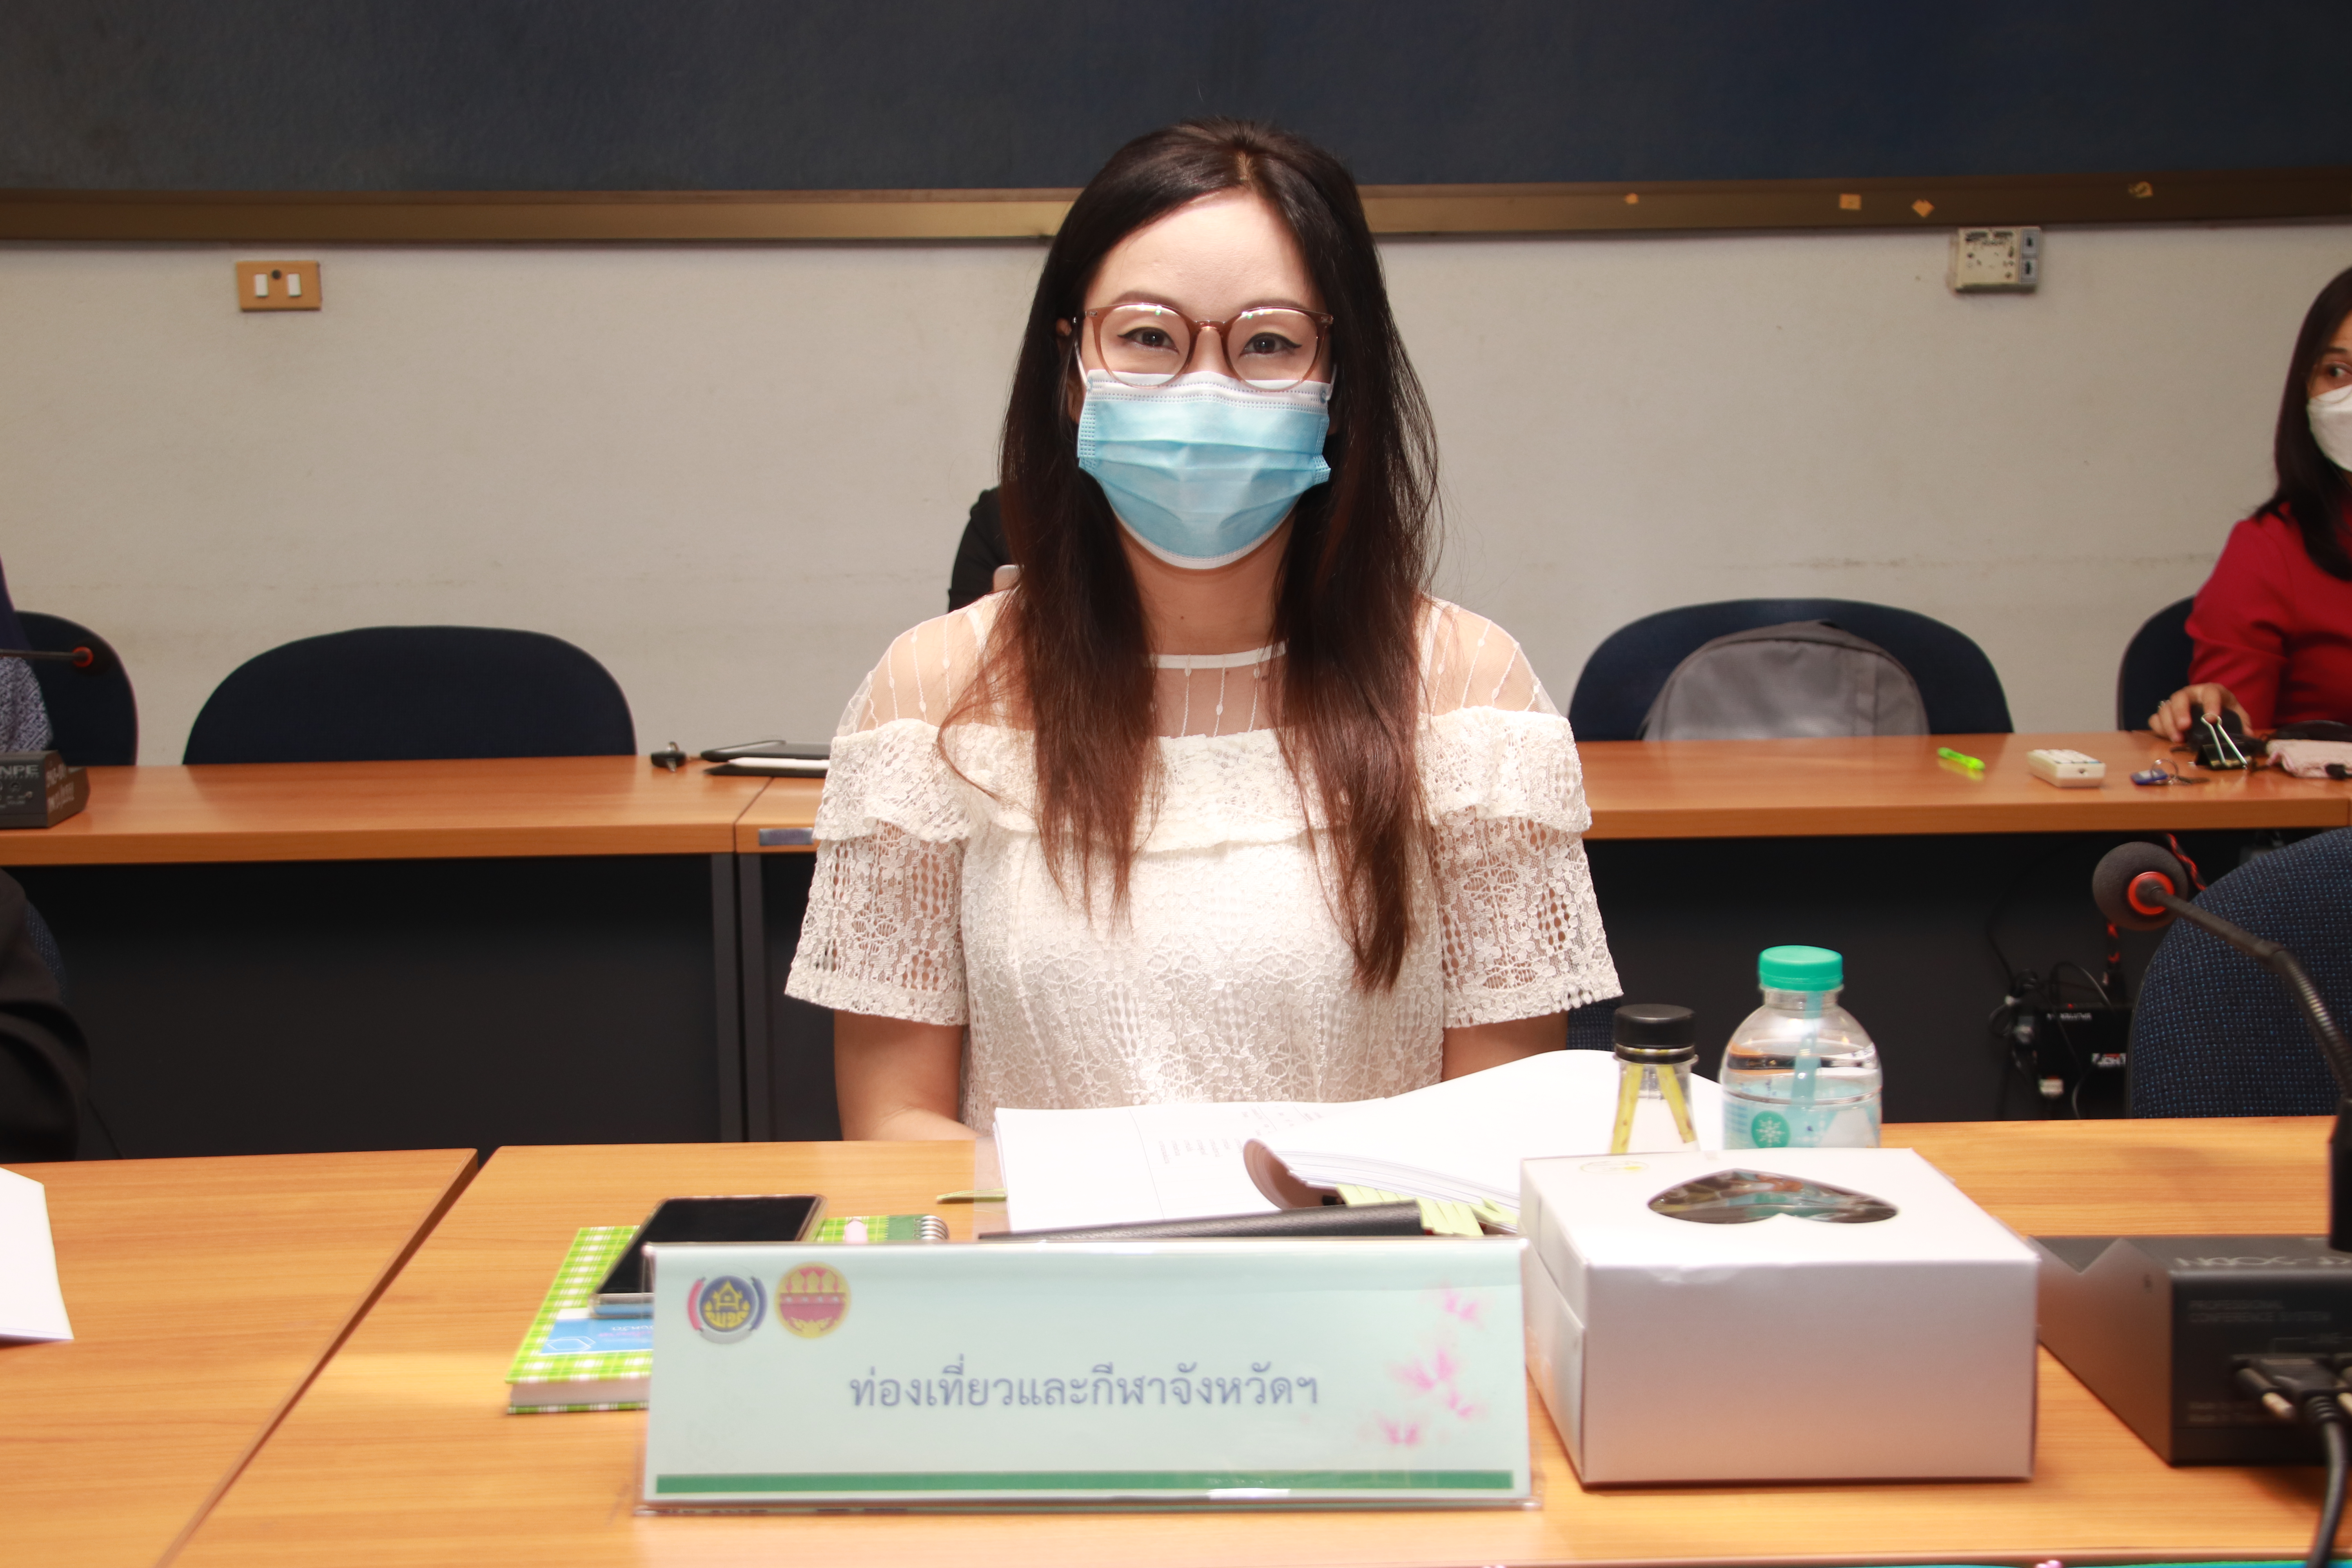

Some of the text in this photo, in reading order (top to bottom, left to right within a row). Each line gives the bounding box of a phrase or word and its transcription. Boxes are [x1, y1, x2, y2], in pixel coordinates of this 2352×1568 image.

[0, 765, 39, 775] NPE
[849, 1354, 1318, 1408] ท่องเที่ยวและกีฬาจังหวัดฯ
